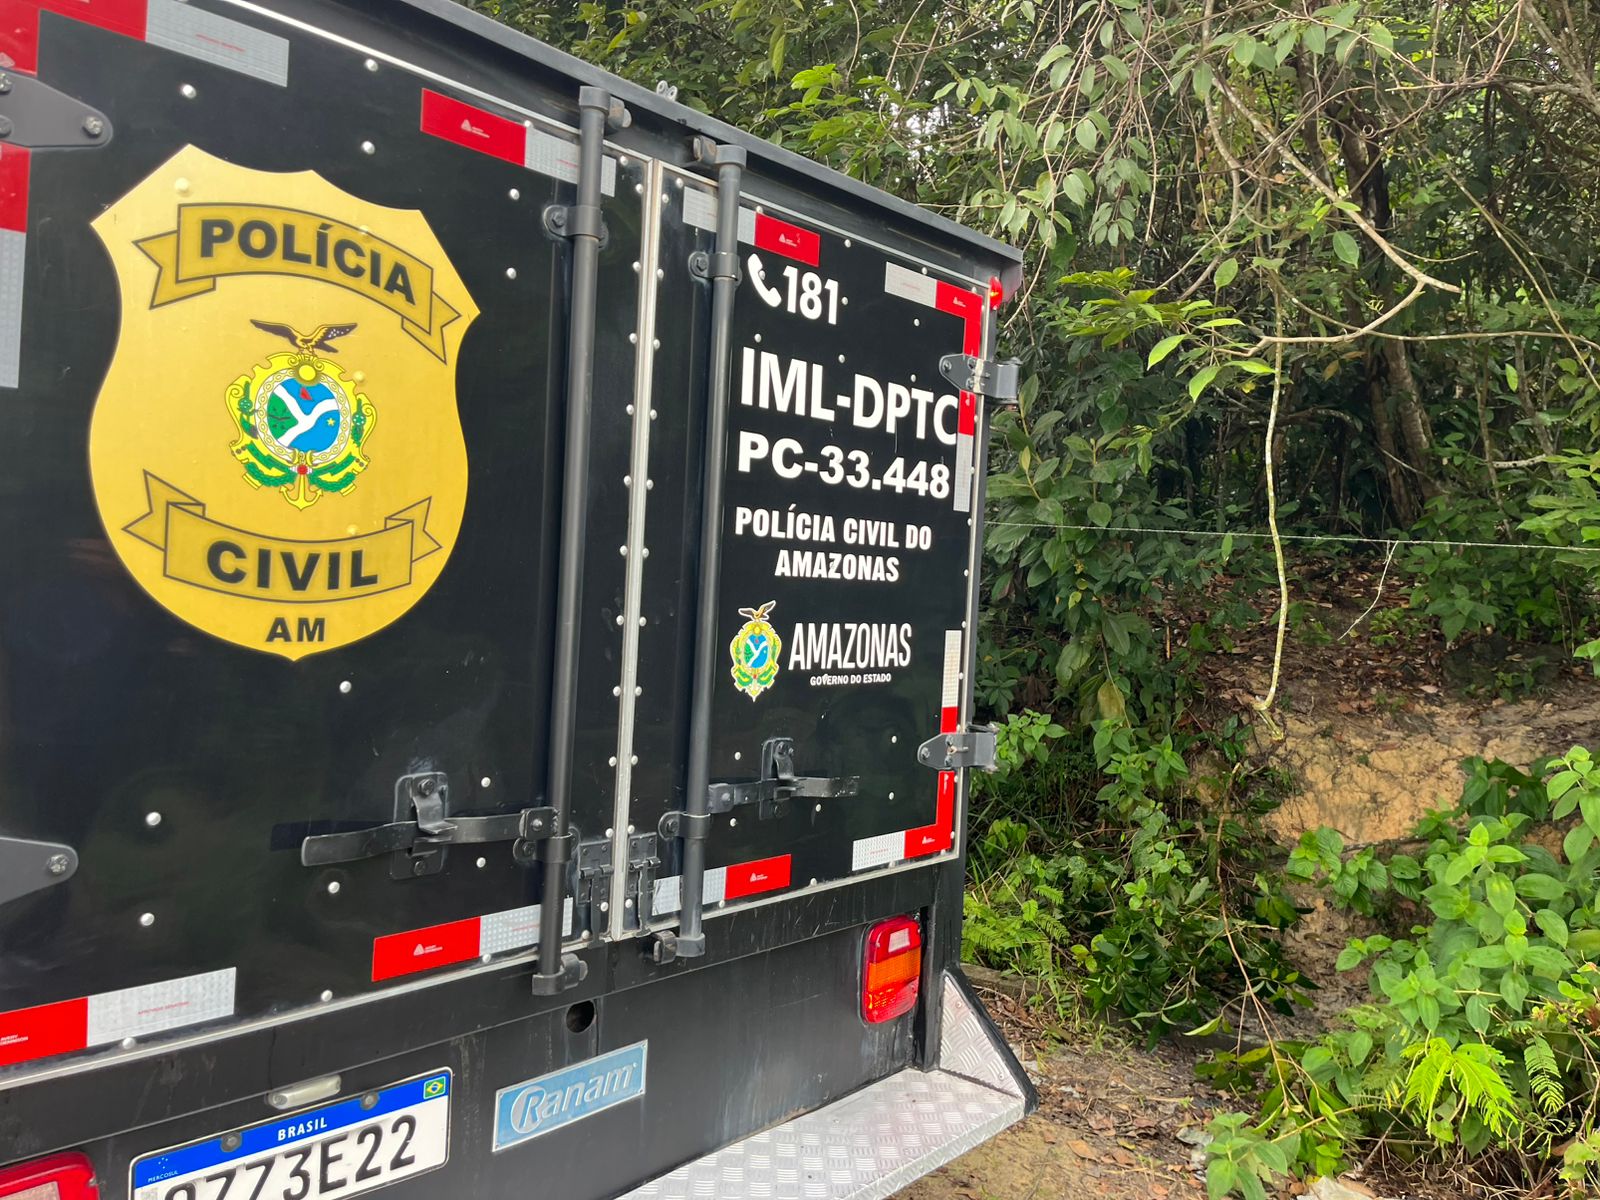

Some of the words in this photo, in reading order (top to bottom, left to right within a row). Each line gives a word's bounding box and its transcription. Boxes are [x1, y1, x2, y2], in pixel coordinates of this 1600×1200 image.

[200, 218, 417, 306] POLÍCIA
[782, 265, 839, 326] 181
[740, 346, 959, 446] IML-DPTC
[737, 430, 950, 499] PC-33.448
[735, 503, 836, 543] POLÍCIA
[843, 517, 900, 548] CIVIL
[905, 524, 932, 551] DO
[206, 540, 379, 592] CIVIL
[775, 549, 900, 583] AMAZONAS
[265, 616, 326, 643] AM
[787, 622, 913, 671] AMAZONAS
[810, 674, 849, 686] GOVERNO
[850, 674, 862, 685] DO
[863, 672, 892, 683] ESTADO
[511, 1065, 634, 1133] Ranam
[277, 1116, 329, 1142] BRASIL
[147, 1170, 179, 1183] MERCOSUL
